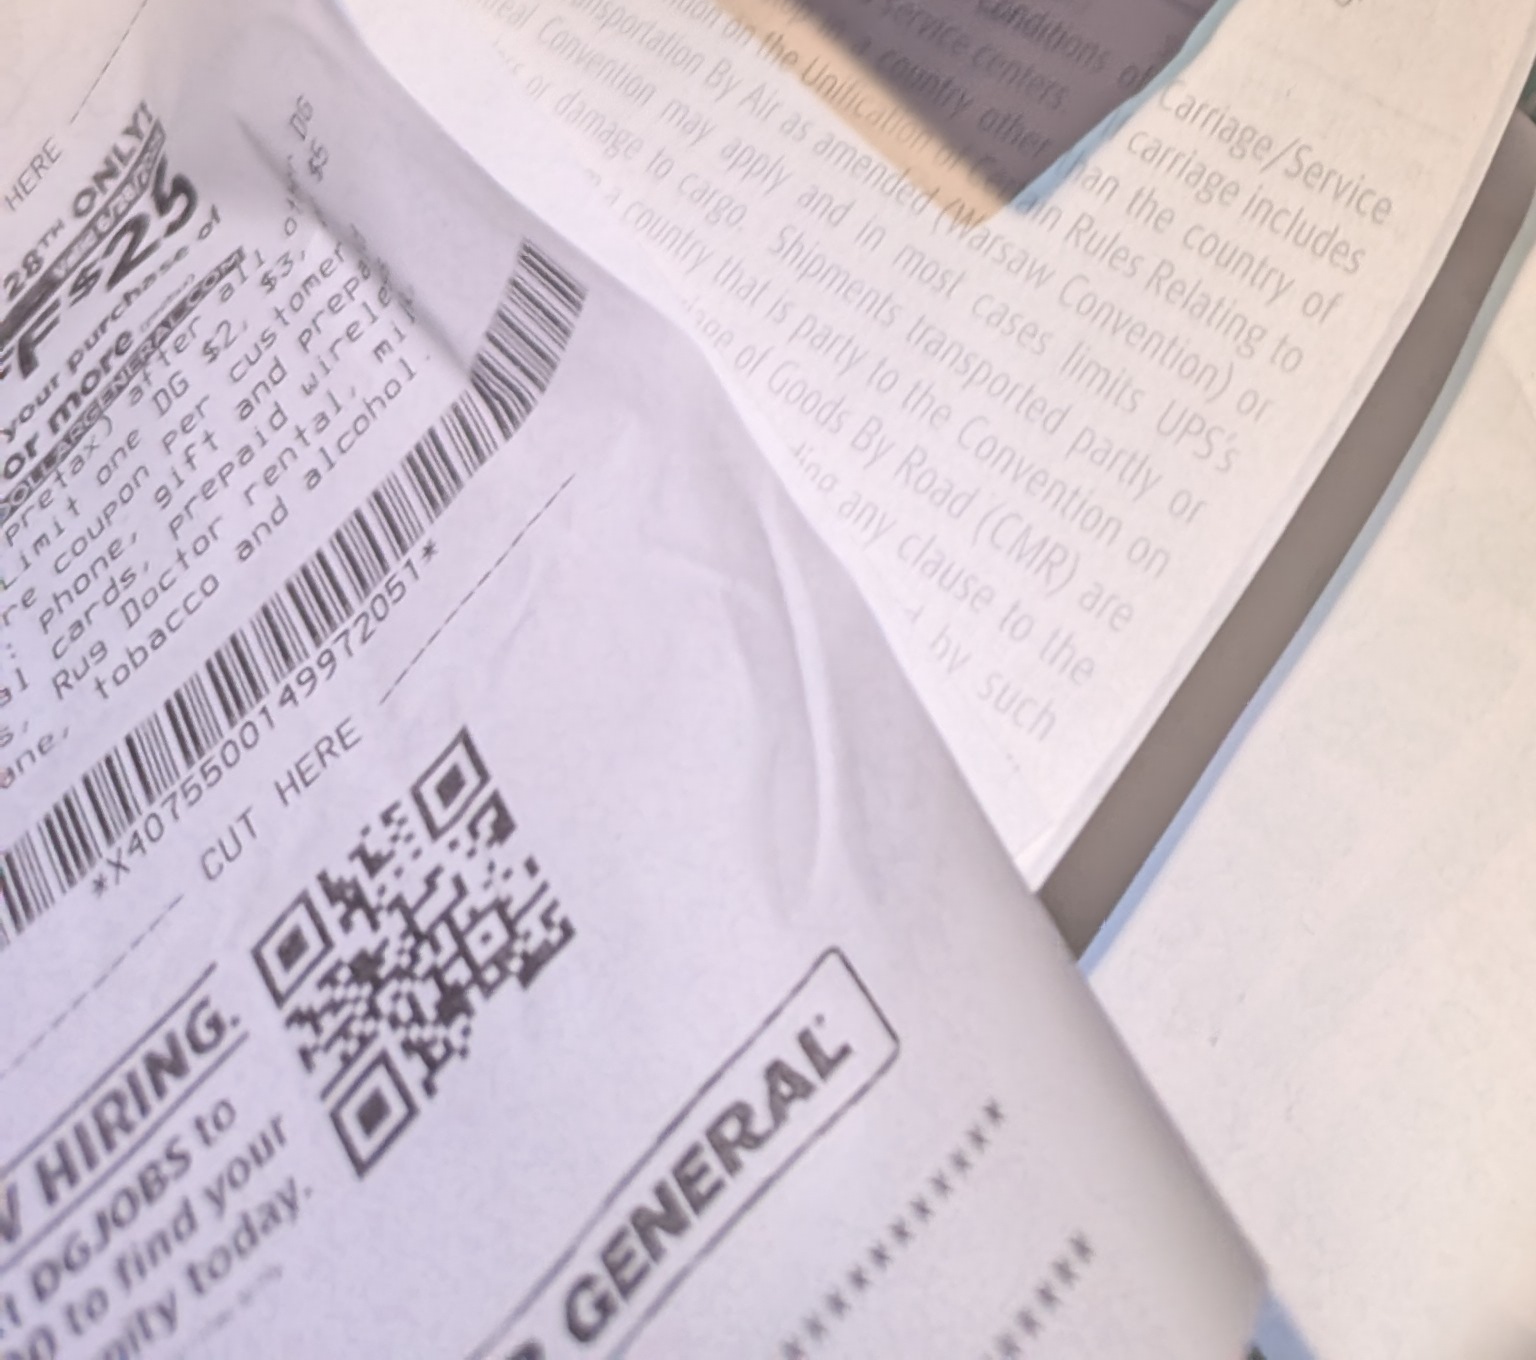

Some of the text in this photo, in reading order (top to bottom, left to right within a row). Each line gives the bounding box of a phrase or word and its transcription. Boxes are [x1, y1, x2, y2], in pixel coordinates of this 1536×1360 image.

[3, 133, 64, 213] HERE
[66, 150, 200, 310] $25
[537, 14, 660, 108] Convention
[657, 97, 721, 149] may
[717, 136, 796, 198] apply
[794, 183, 858, 231] and
[852, 211, 888, 254] in
[890, 242, 968, 302] most
[968, 292, 1056, 358] cases
[1057, 339, 1147, 416] limits
[1153, 398, 1243, 476] UPS's
[703, 56, 745, 104] By
[737, 80, 786, 124] Air
[777, 110, 817, 143] as
[811, 131, 942, 216] amended
[929, 183, 1058, 292] (Warsaw
[1056, 272, 1235, 406] Convention)
[1233, 385, 1277, 423] or
[757, 29, 801, 67] the
[1061, 210, 1146, 281] Rules
[1143, 257, 1270, 361] Relating
[1268, 330, 1304, 376] to
[1124, 129, 1242, 206] carriage
[1240, 182, 1367, 276] includes
[1124, 183, 1177, 235] the
[1181, 224, 1298, 309] country
[1159, 78, 1395, 226] Carriage/Service
[0, 372, 60, 444] your
[66, 243, 192, 374] purchase
[3, 412, 115, 548] pretax)
[127, 314, 202, 408] after
[218, 247, 266, 304] all
[46, 326, 136, 437] more
[551, 86, 646, 162] damage
[644, 144, 677, 185] to
[765, 221, 905, 331] Shipments
[903, 312, 1076, 438] transported
[1062, 423, 1167, 504] partly
[1164, 487, 1212, 527] or
[622, 198, 717, 278] country
[711, 253, 774, 310] that
[763, 287, 796, 326] is
[785, 311, 873, 380] party
[863, 354, 903, 397] to
[899, 377, 955, 432] the
[954, 414, 1126, 549] Convention
[1124, 534, 1177, 582] on
[38, 532, 140, 636] phone,
[153, 427, 220, 511] gift
[235, 354, 290, 422] and
[51, 559, 152, 662] cards,
[167, 400, 290, 542] prepaid
[53, 463, 152, 576] coupon
[160, 392, 212, 457] per
[97, 428, 142, 488] one
[151, 368, 191, 421] DG
[765, 358, 852, 437] Goods
[848, 412, 898, 473] By
[892, 442, 983, 522] Road
[968, 499, 1084, 601] (CMR)
[1076, 579, 1137, 634] are
[51, 384, 358, 702] Rug Doctor rental,
[94, 572, 222, 702] tobacco
[234, 494, 290, 563] and
[837, 488, 1096, 688] any clause to the
[199, 714, 364, 884] CUT HERE
[974, 669, 1060, 740] such
[29, 1134, 193, 1304] DGJOBS
[194, 1098, 238, 1148] to
[34, 994, 241, 1208] HIRING.
[563, 1026, 853, 1344] GENERAL
[65, 1285, 110, 1337] to
[115, 1194, 199, 1293] find
[204, 1113, 288, 1221] your
[186, 1175, 314, 1297] today.
